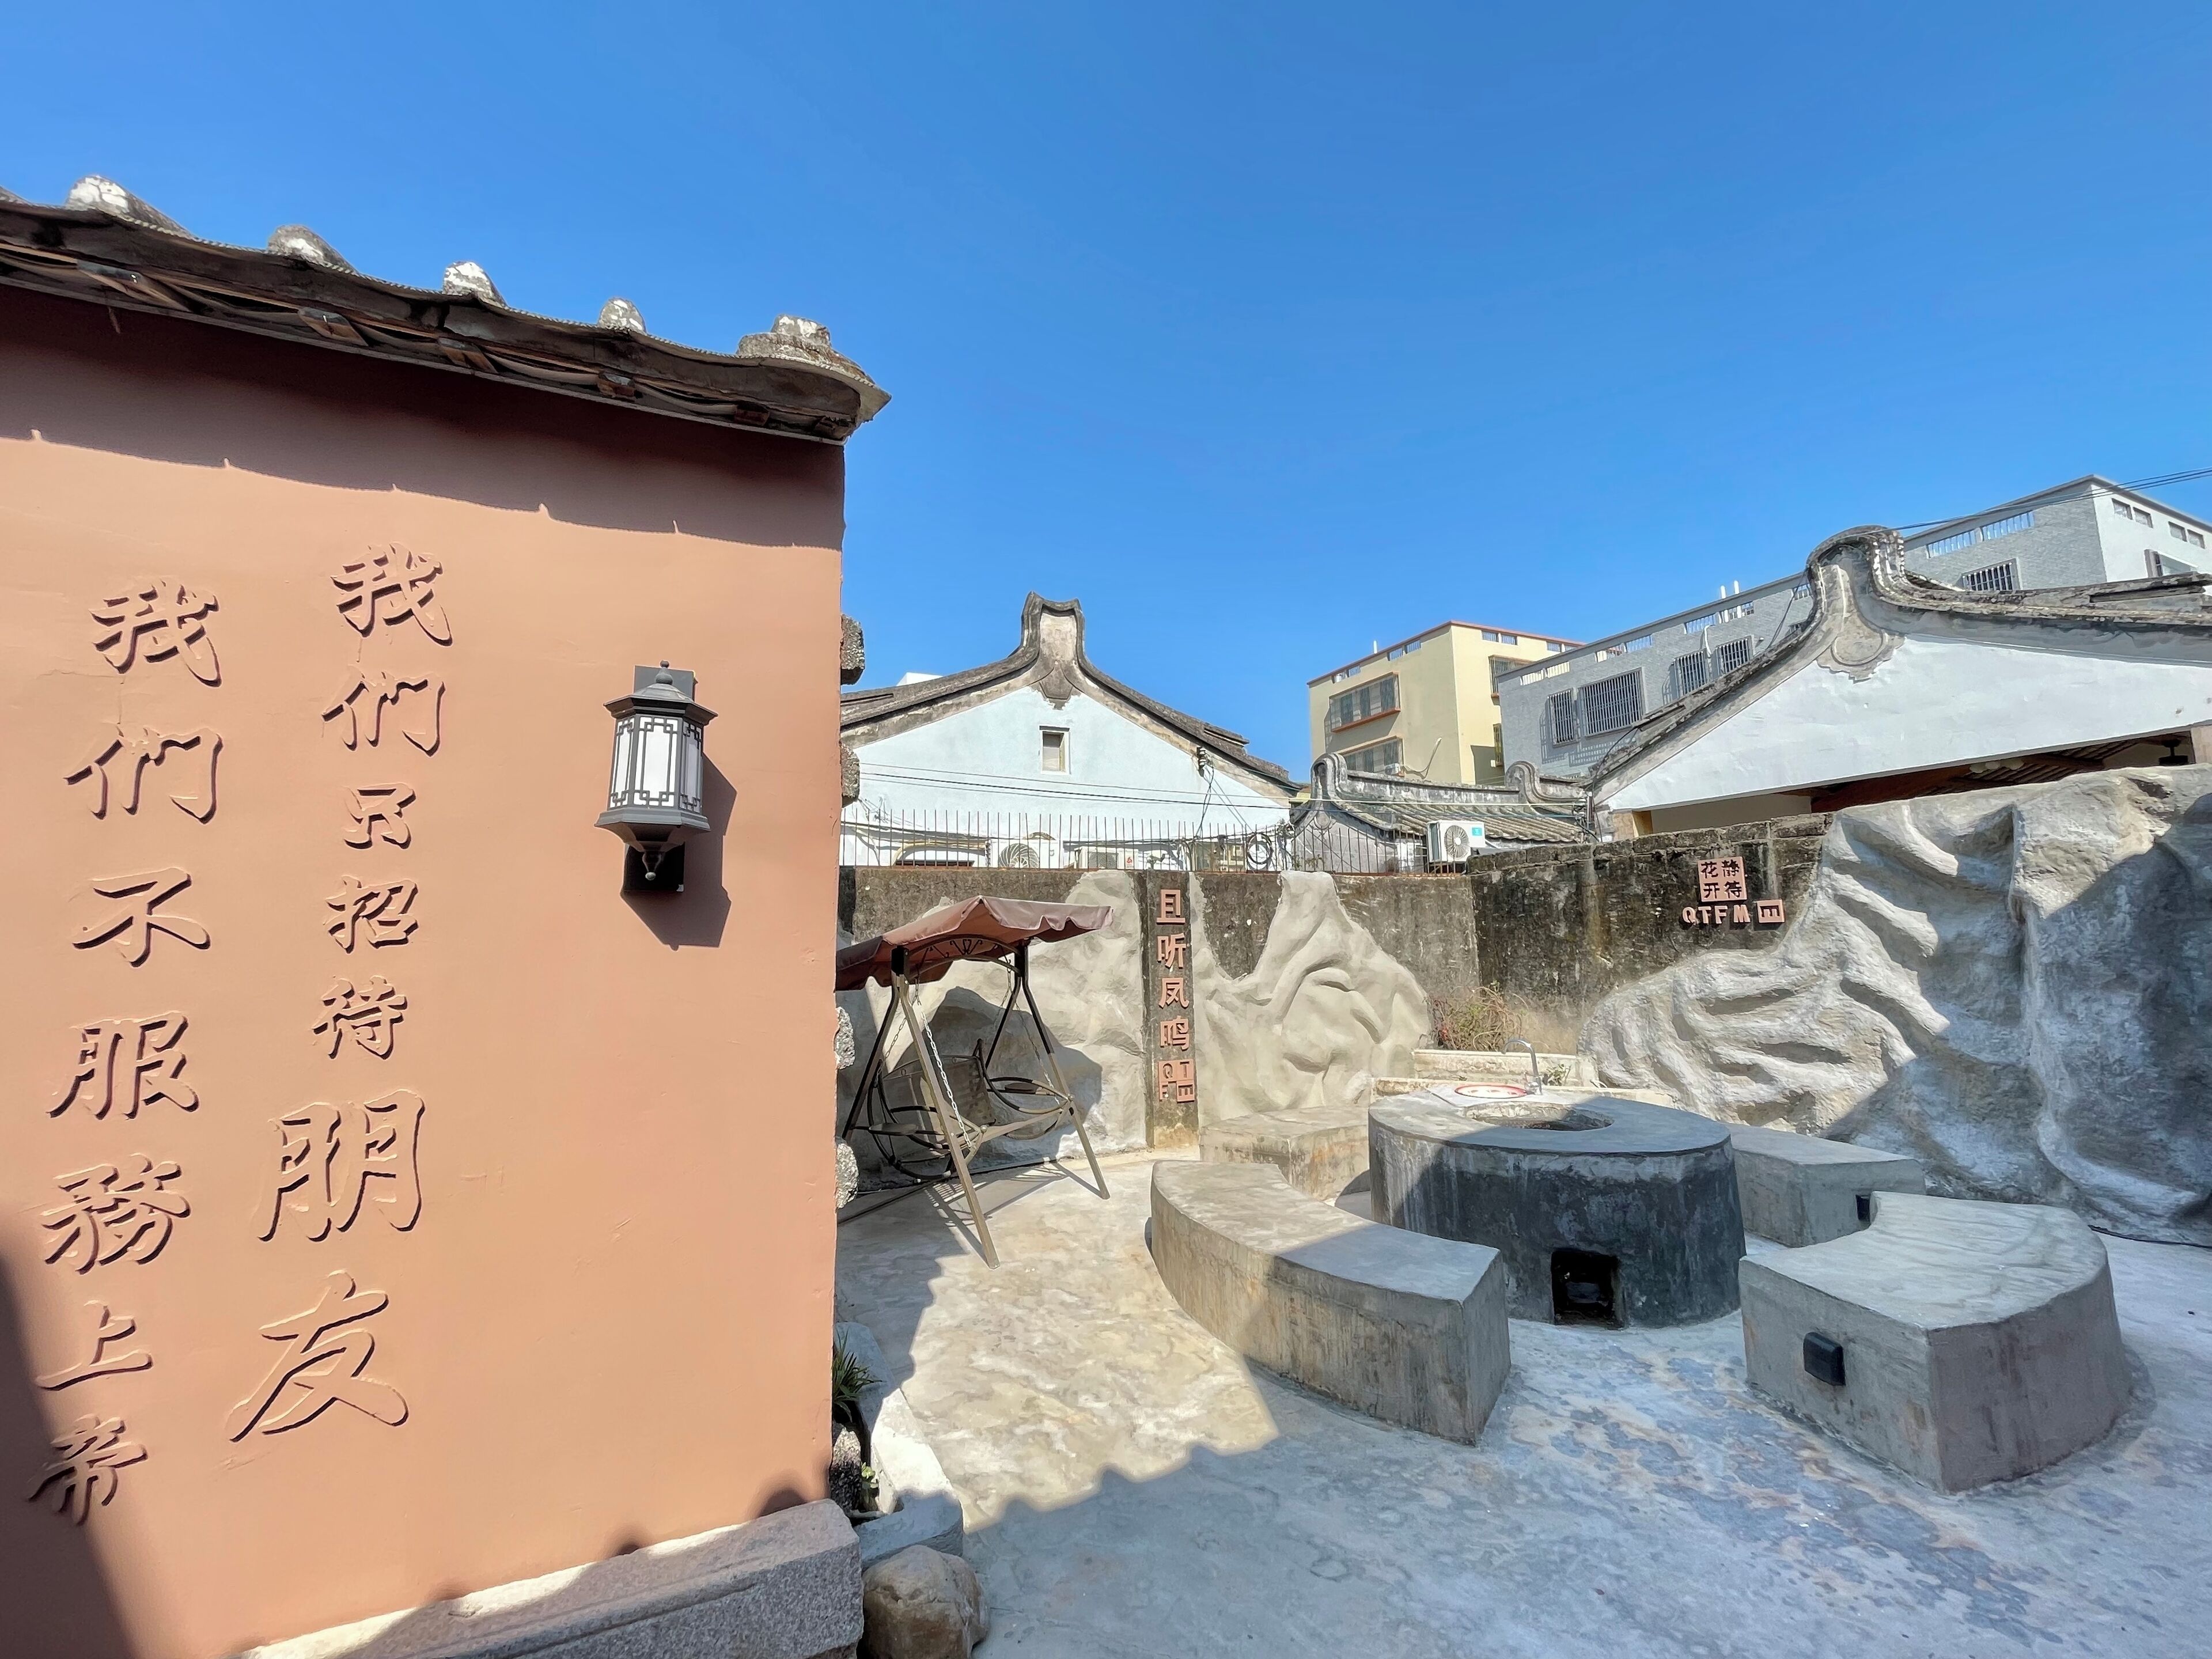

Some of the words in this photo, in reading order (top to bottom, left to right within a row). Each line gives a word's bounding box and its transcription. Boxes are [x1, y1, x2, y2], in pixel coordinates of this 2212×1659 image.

[1682, 904, 1751, 925] QTFM
[1156, 889, 1189, 1051] 且听凤鸣
